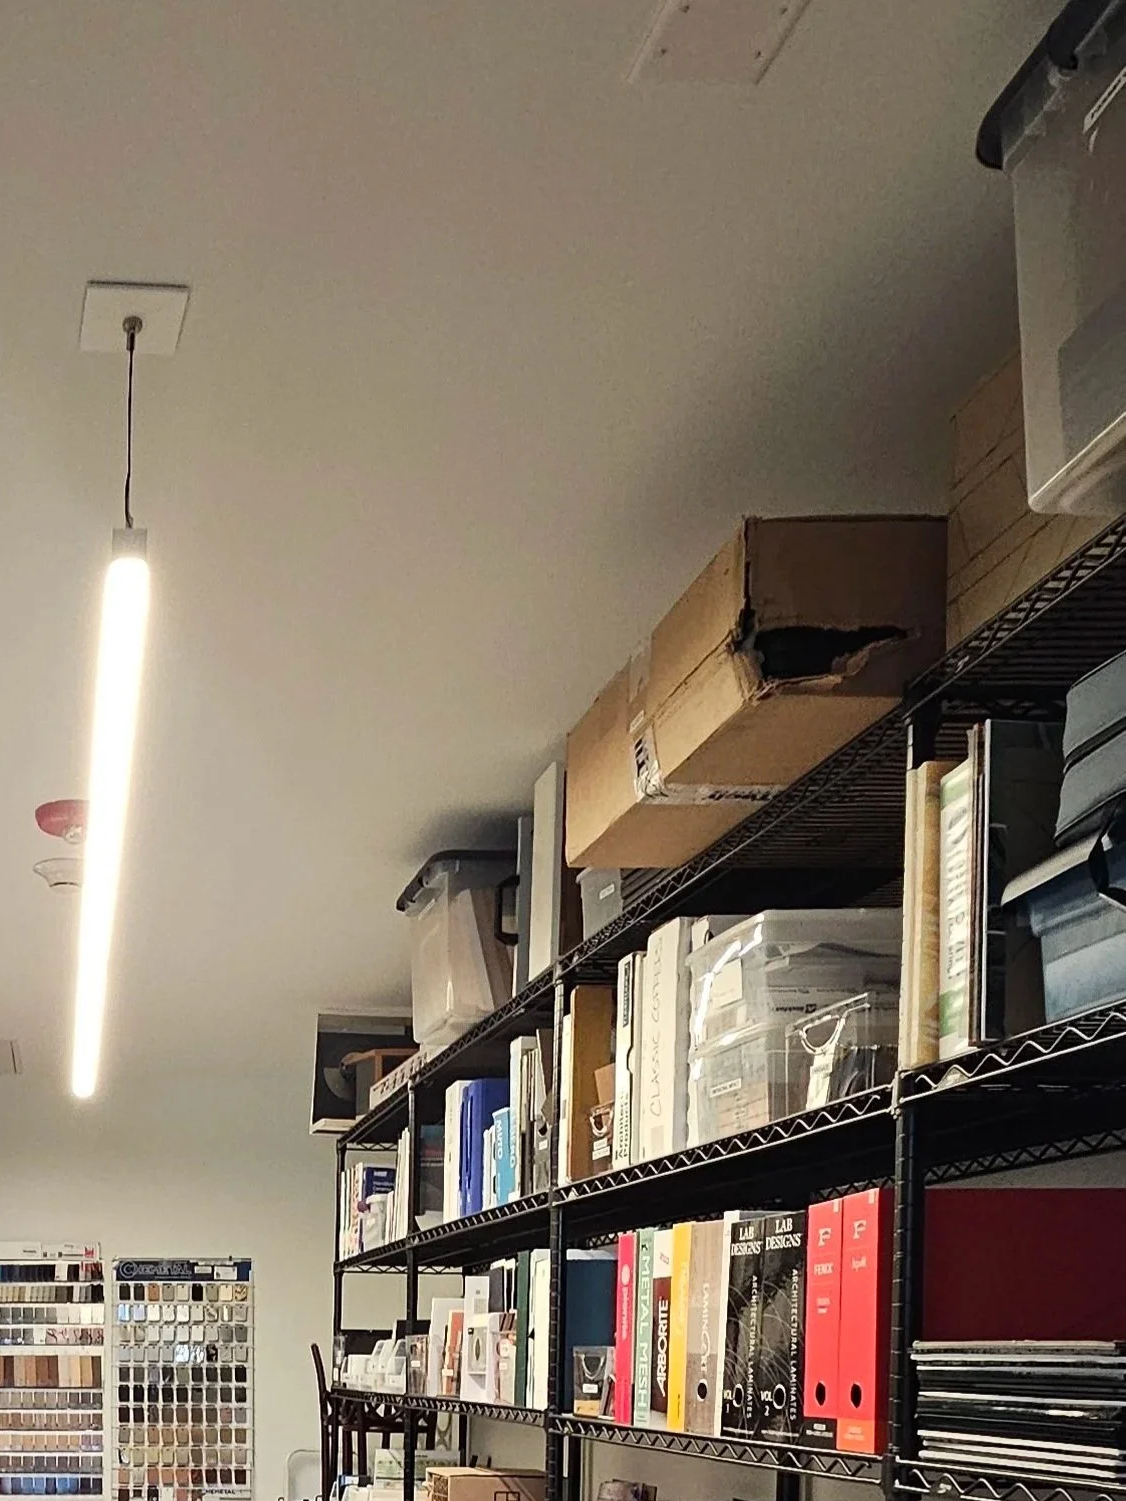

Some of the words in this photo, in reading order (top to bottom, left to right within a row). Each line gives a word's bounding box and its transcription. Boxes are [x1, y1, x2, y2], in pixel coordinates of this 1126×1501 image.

[649, 1032, 662, 1117] CLASSIC
[494, 1119, 503, 1161] MUTO
[731, 1241, 763, 1256] DESIGNS
[739, 1226, 755, 1241] LAB
[766, 1233, 802, 1250] DESIGNS
[775, 1217, 793, 1233] LAB
[640, 1255, 651, 1334] METAL
[749, 1275, 758, 1357] ARCHITECTURAL
[790, 1269, 799, 1357] ARCHITECTURAL
[638, 1341, 649, 1408] MESH
[656, 1298, 668, 1398] ARBORITE
[746, 1361, 754, 1419] LAMINATES
[760, 1390, 773, 1402] VOL
[764, 1406, 770, 1416] 2
[789, 1361, 797, 1421] LAMINATES
